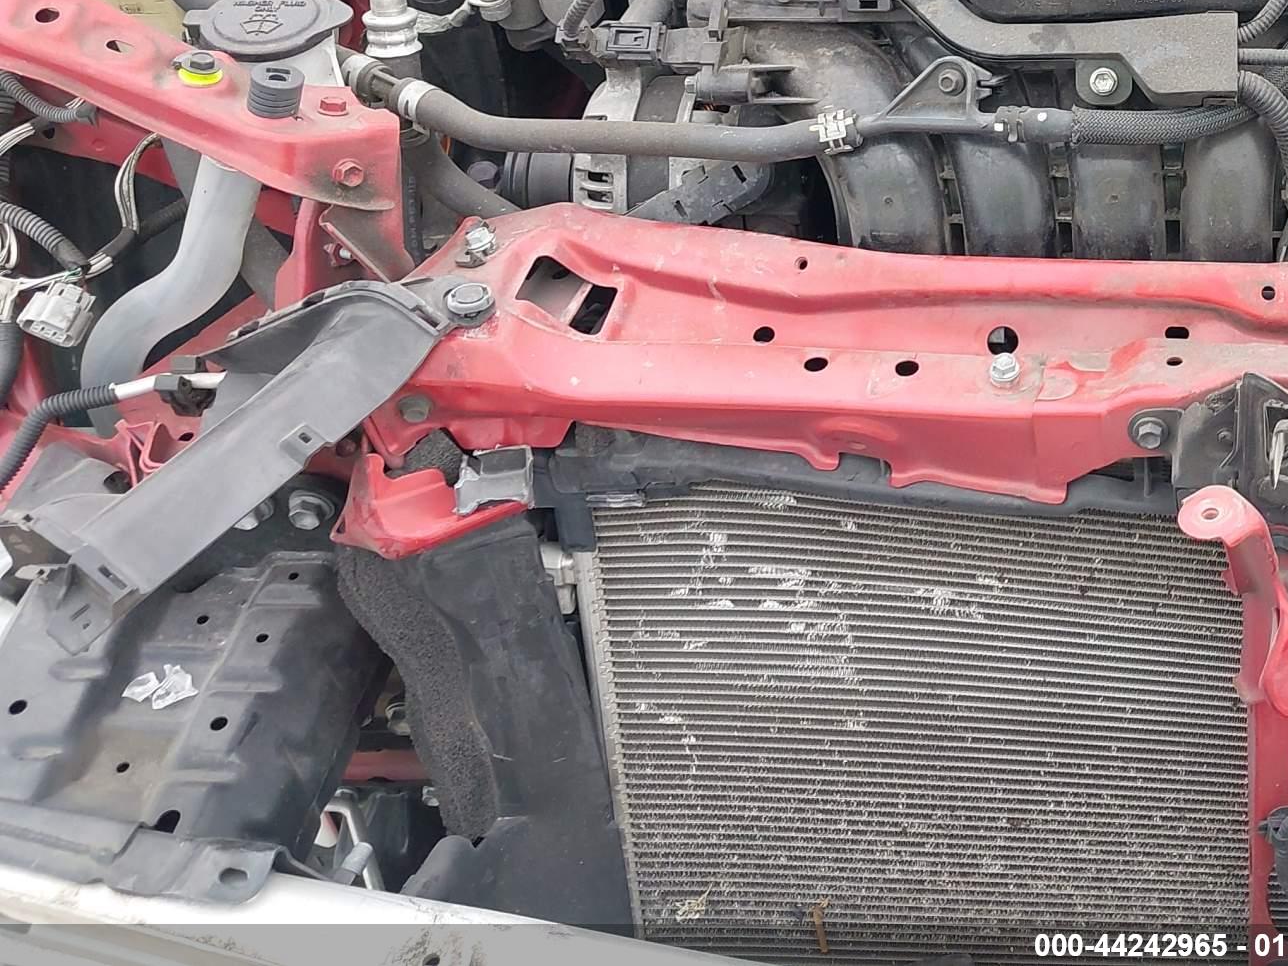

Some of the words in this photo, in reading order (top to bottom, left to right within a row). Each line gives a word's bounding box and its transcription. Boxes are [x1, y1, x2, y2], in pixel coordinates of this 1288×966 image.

[232, 0, 274, 8] WASHER
[279, 0, 308, 8] FLUID
[254, 5, 282, 13] ONLY
